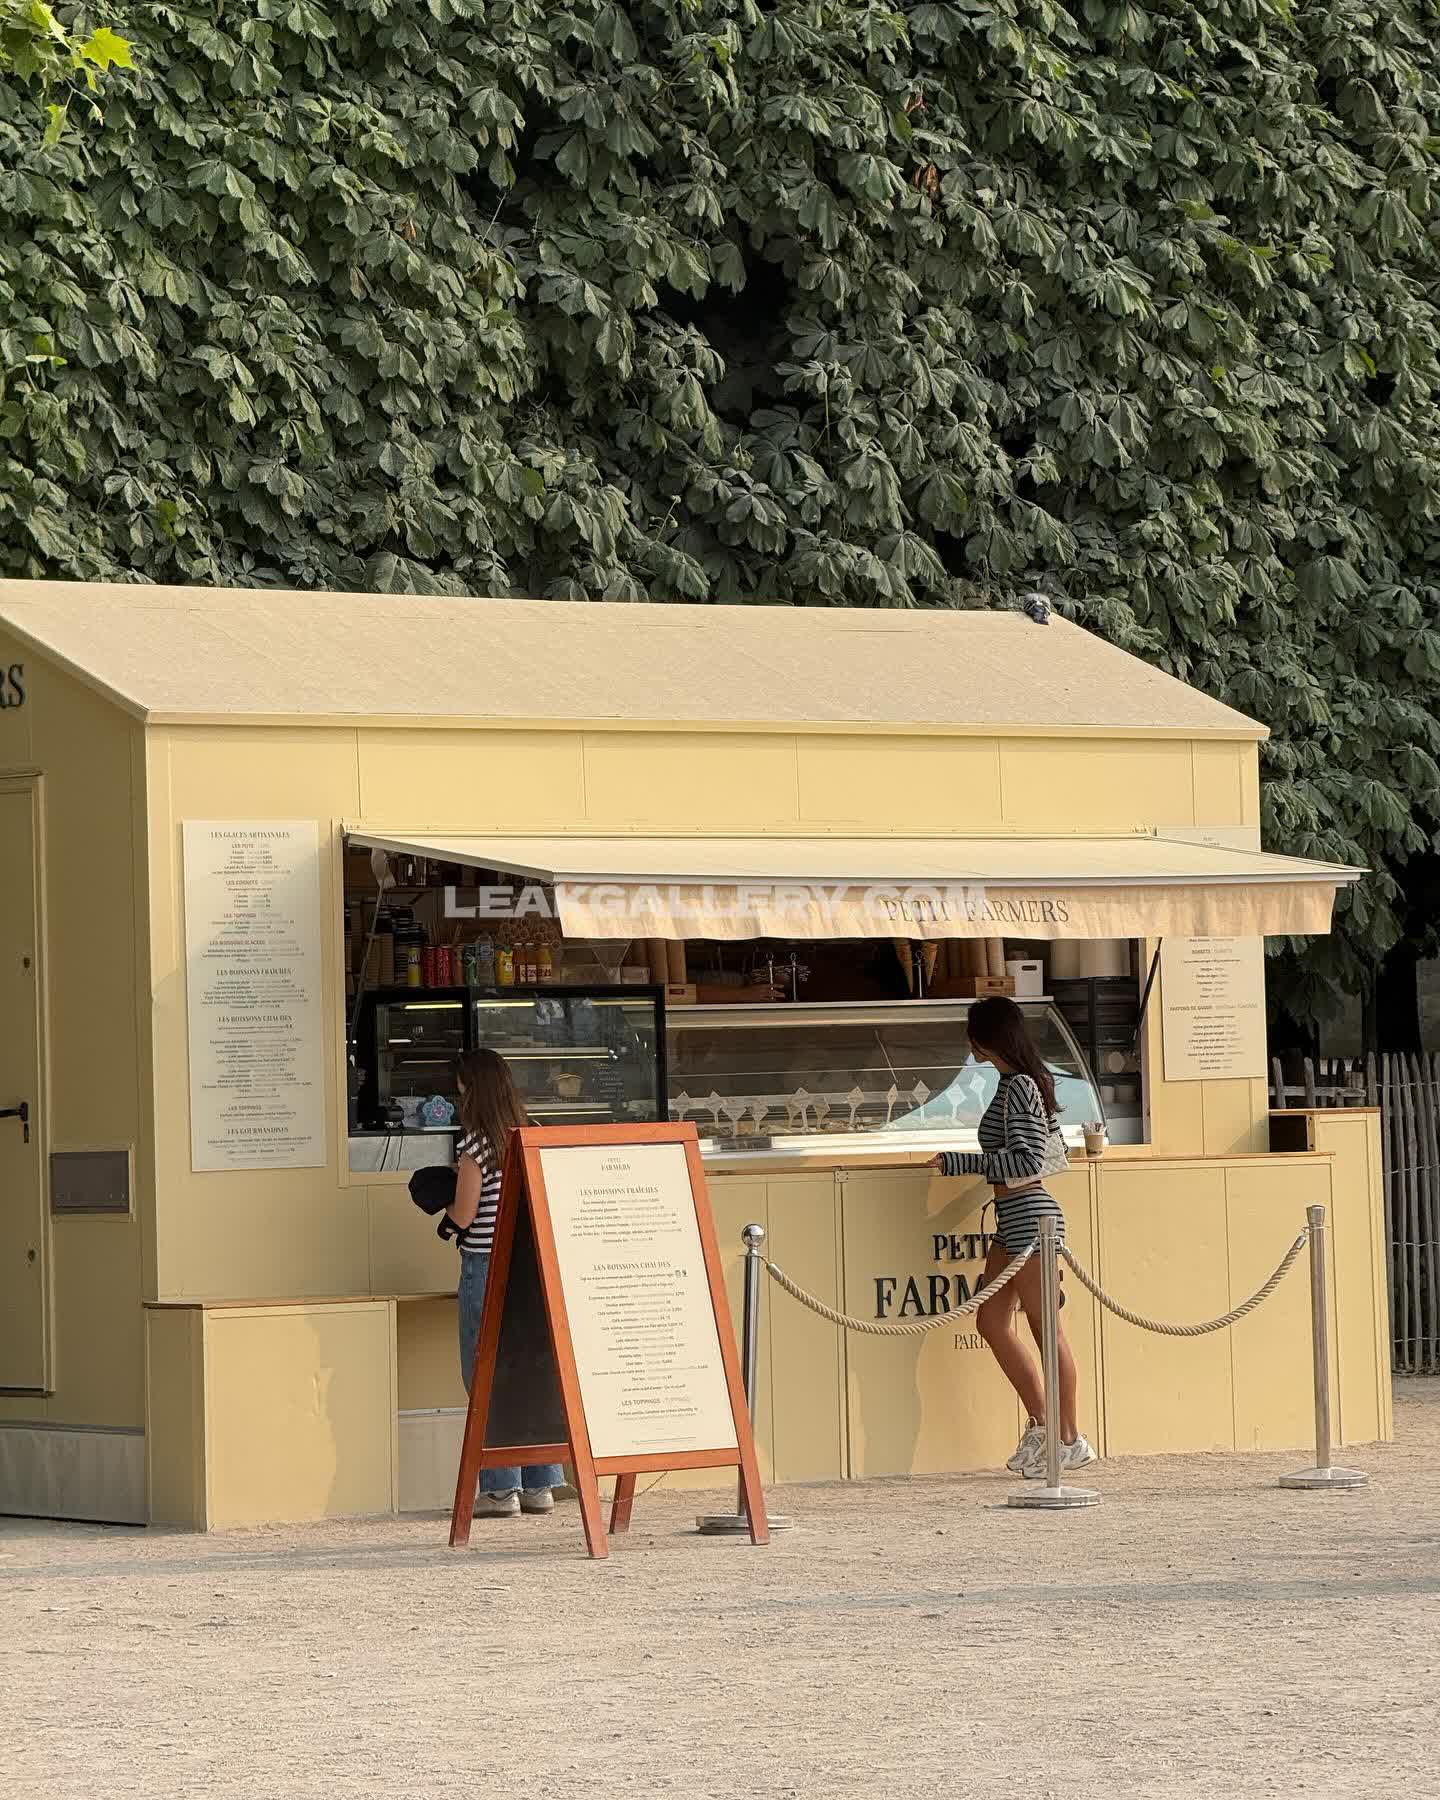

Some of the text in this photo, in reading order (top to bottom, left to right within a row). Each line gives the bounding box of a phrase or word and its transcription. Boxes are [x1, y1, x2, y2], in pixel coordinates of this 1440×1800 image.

[0, 664, 25, 709] S
[883, 899, 1070, 923] PETIT FARMERS
[580, 1189, 593, 1197] LES
[593, 1187, 626, 1196] BOISSONS
[932, 1233, 992, 1260] PETI
[954, 1334, 991, 1350] PARI
